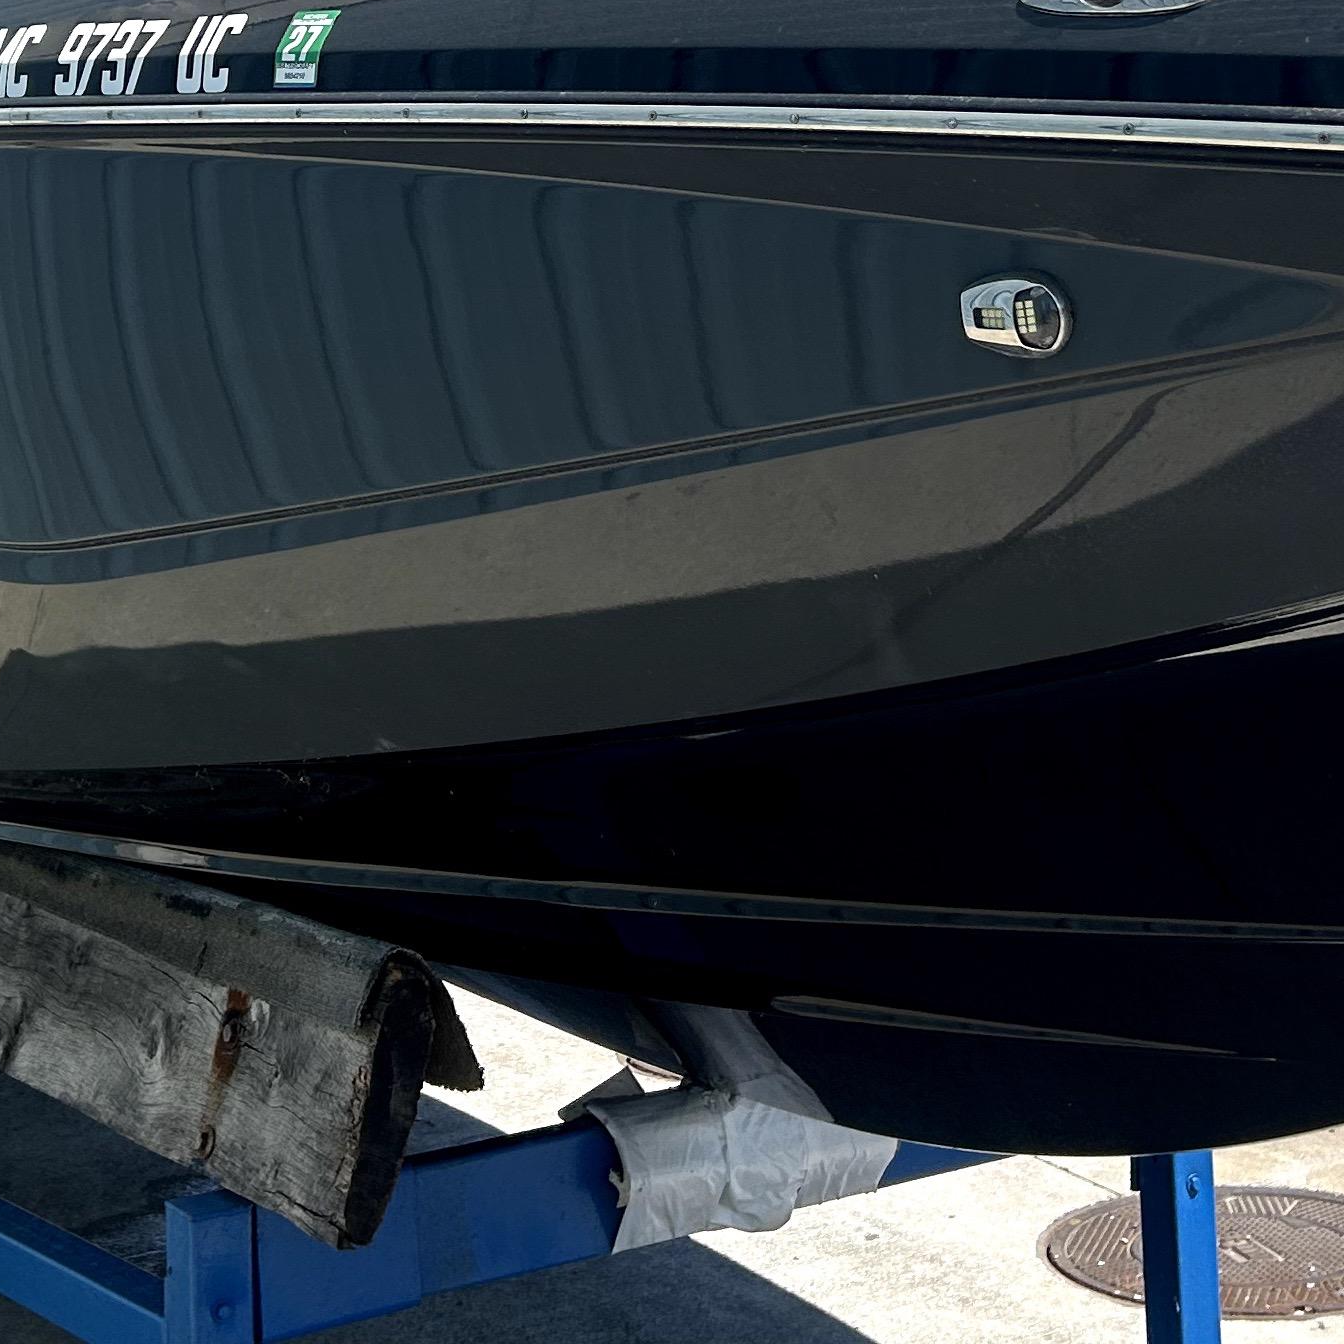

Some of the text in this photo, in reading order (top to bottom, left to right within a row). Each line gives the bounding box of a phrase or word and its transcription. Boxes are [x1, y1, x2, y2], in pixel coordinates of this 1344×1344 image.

[54, 20, 171, 96] 9737
[177, 14, 248, 94] UC
[281, 25, 325, 62] 27
